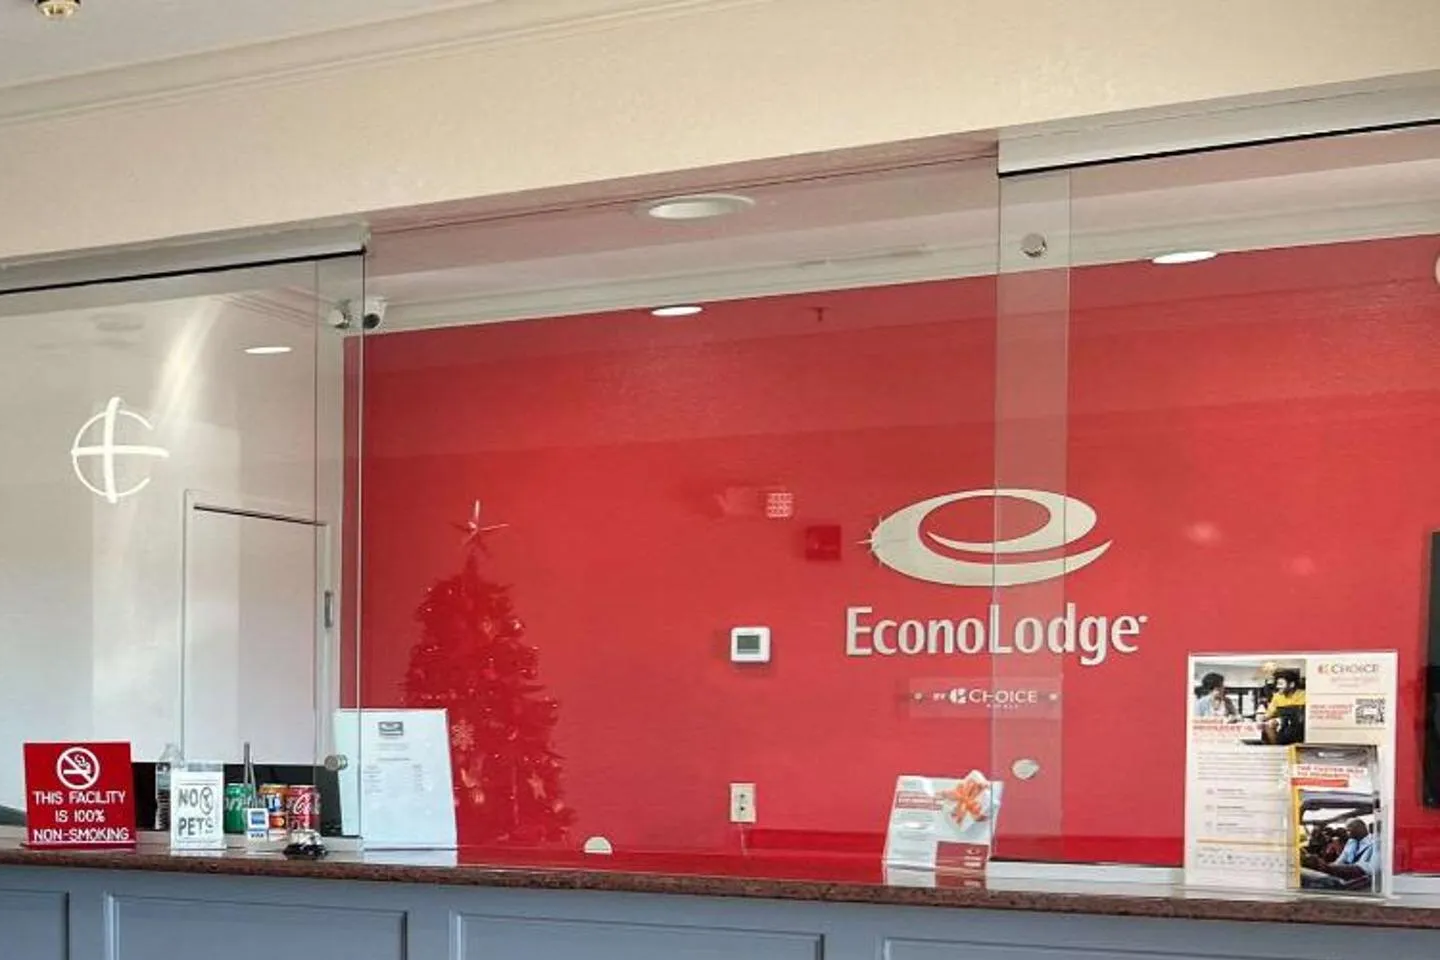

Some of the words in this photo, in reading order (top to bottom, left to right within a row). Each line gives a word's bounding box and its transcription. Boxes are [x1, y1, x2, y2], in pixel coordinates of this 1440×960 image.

[846, 602, 1141, 666] EconoLodge
[969, 689, 1037, 704] CHOICE
[33, 790, 64, 805] THIS
[69, 790, 126, 804] FACILITY
[178, 788, 198, 807] NO
[55, 809, 68, 823] IS
[74, 809, 106, 823] 100%
[33, 827, 129, 841] NON-SMOKING
